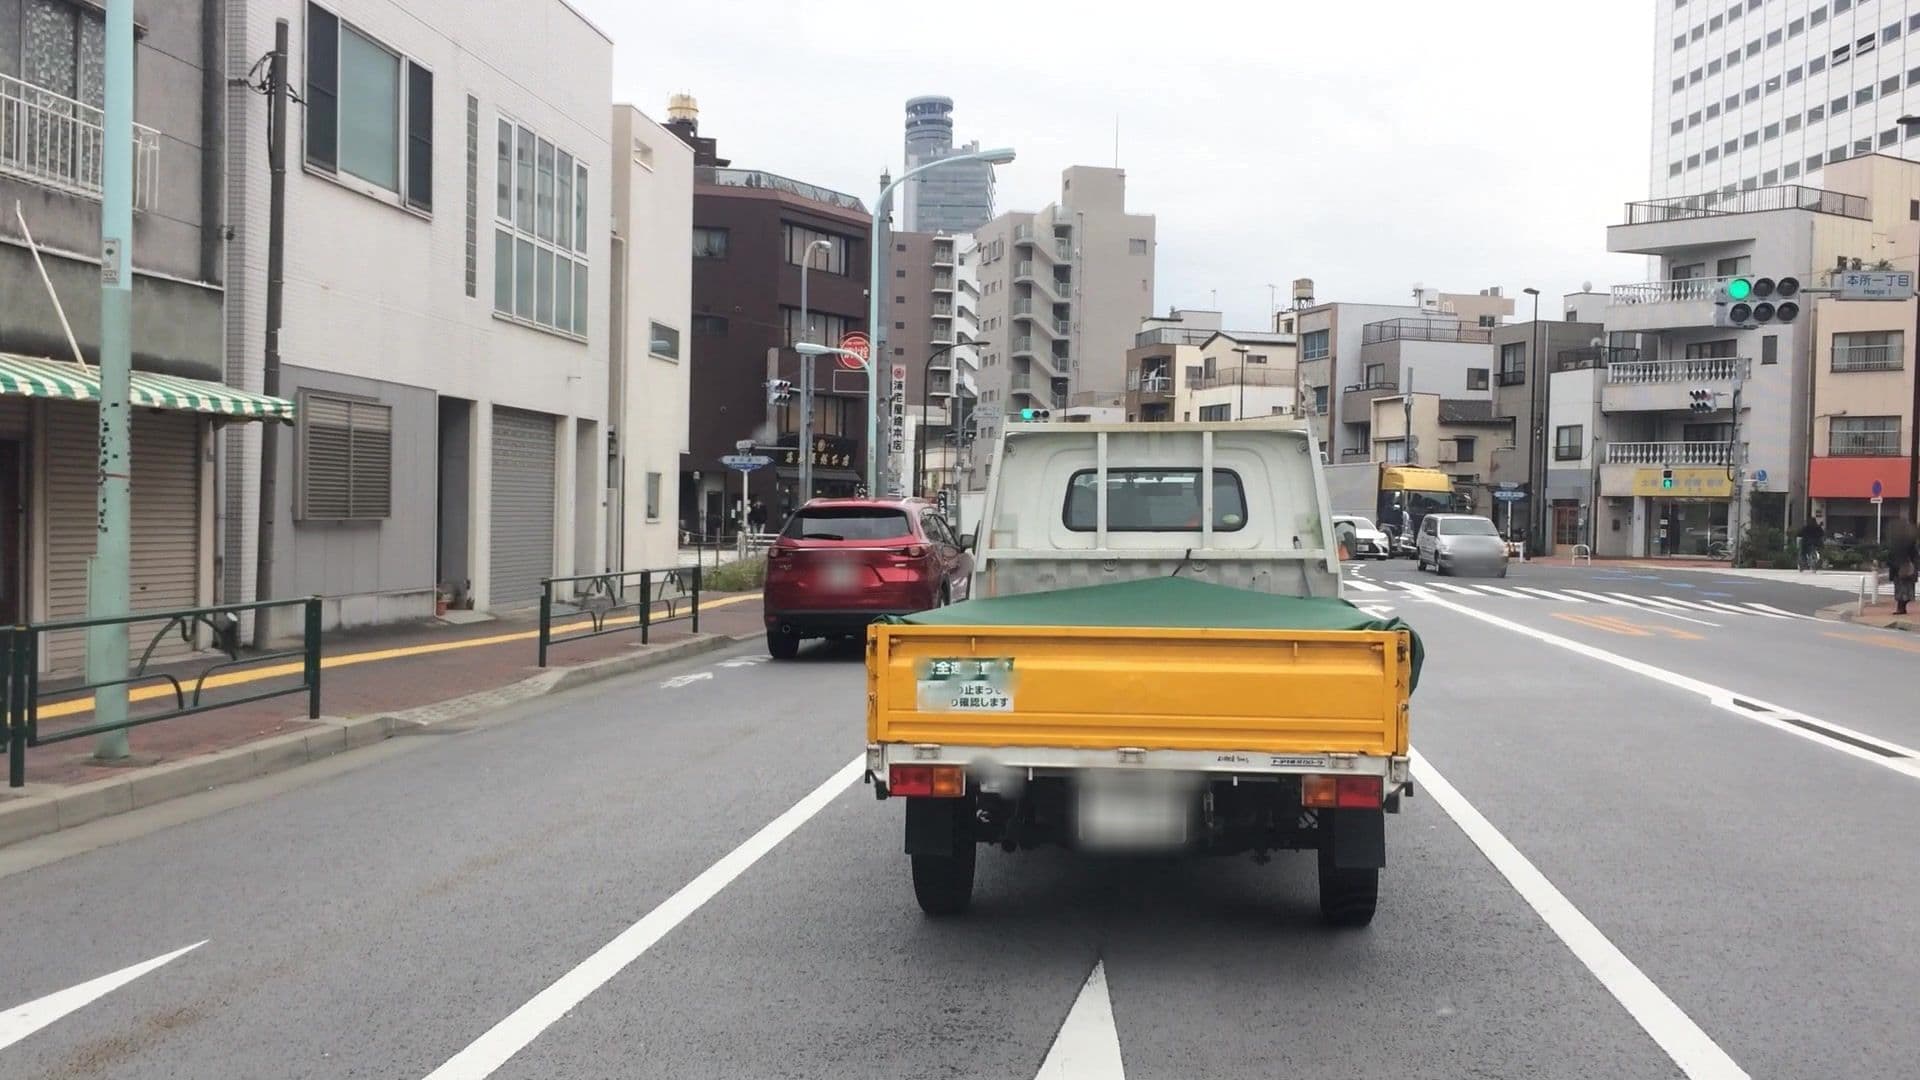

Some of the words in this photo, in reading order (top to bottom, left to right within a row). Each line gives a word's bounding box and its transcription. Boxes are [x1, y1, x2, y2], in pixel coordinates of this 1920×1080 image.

[1847, 274, 1909, 287] 本所一丁目
